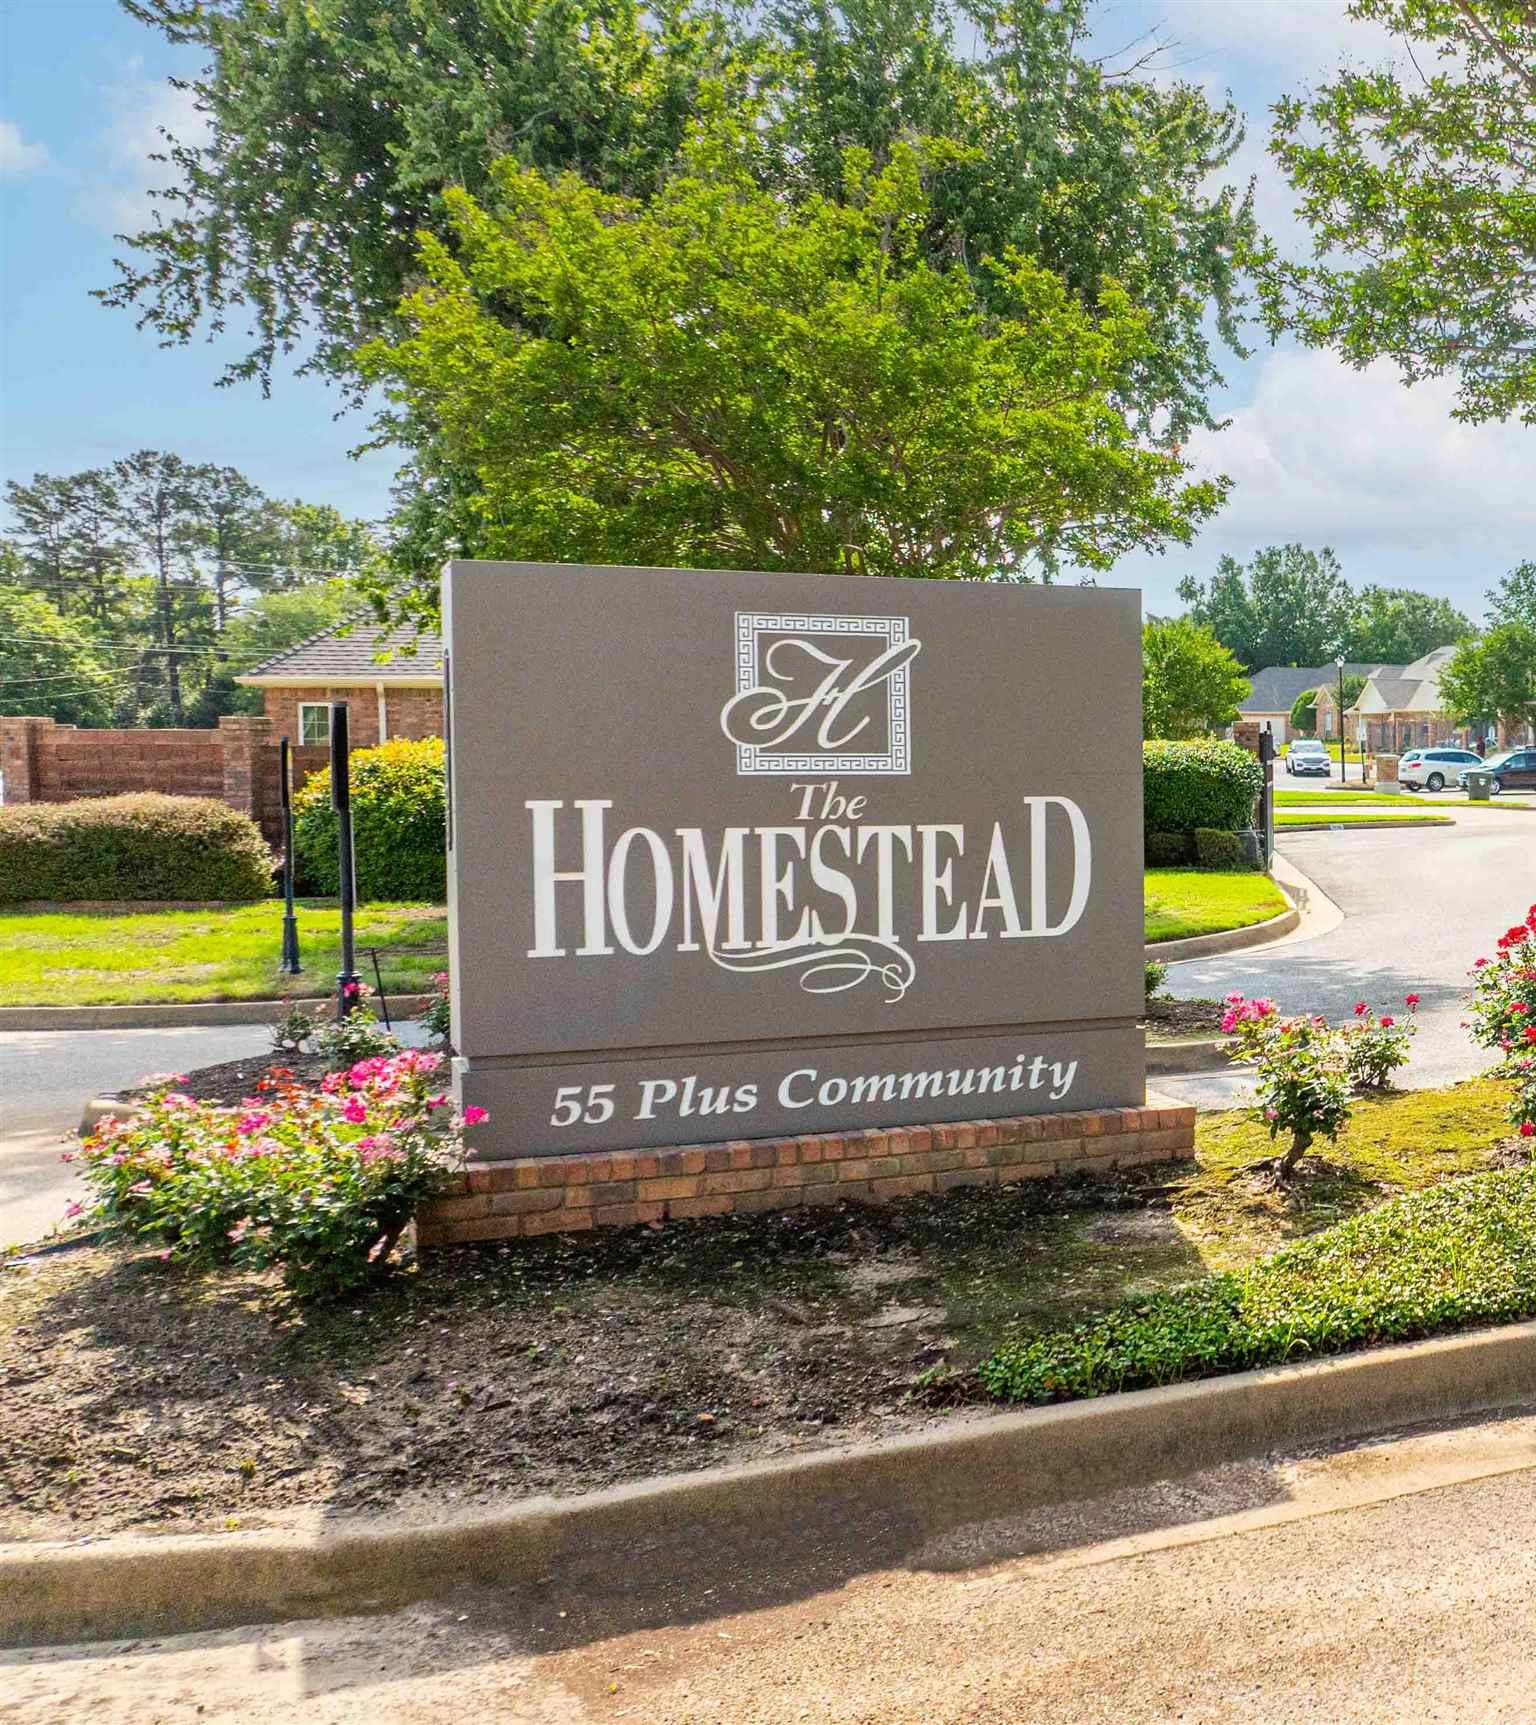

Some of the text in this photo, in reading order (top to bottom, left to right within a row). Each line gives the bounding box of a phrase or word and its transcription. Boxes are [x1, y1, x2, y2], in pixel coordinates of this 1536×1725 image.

[790, 781, 868, 822] The
[525, 795, 1092, 960] HOMESTEAD
[549, 1054, 1079, 1128] 55 Plus Community
